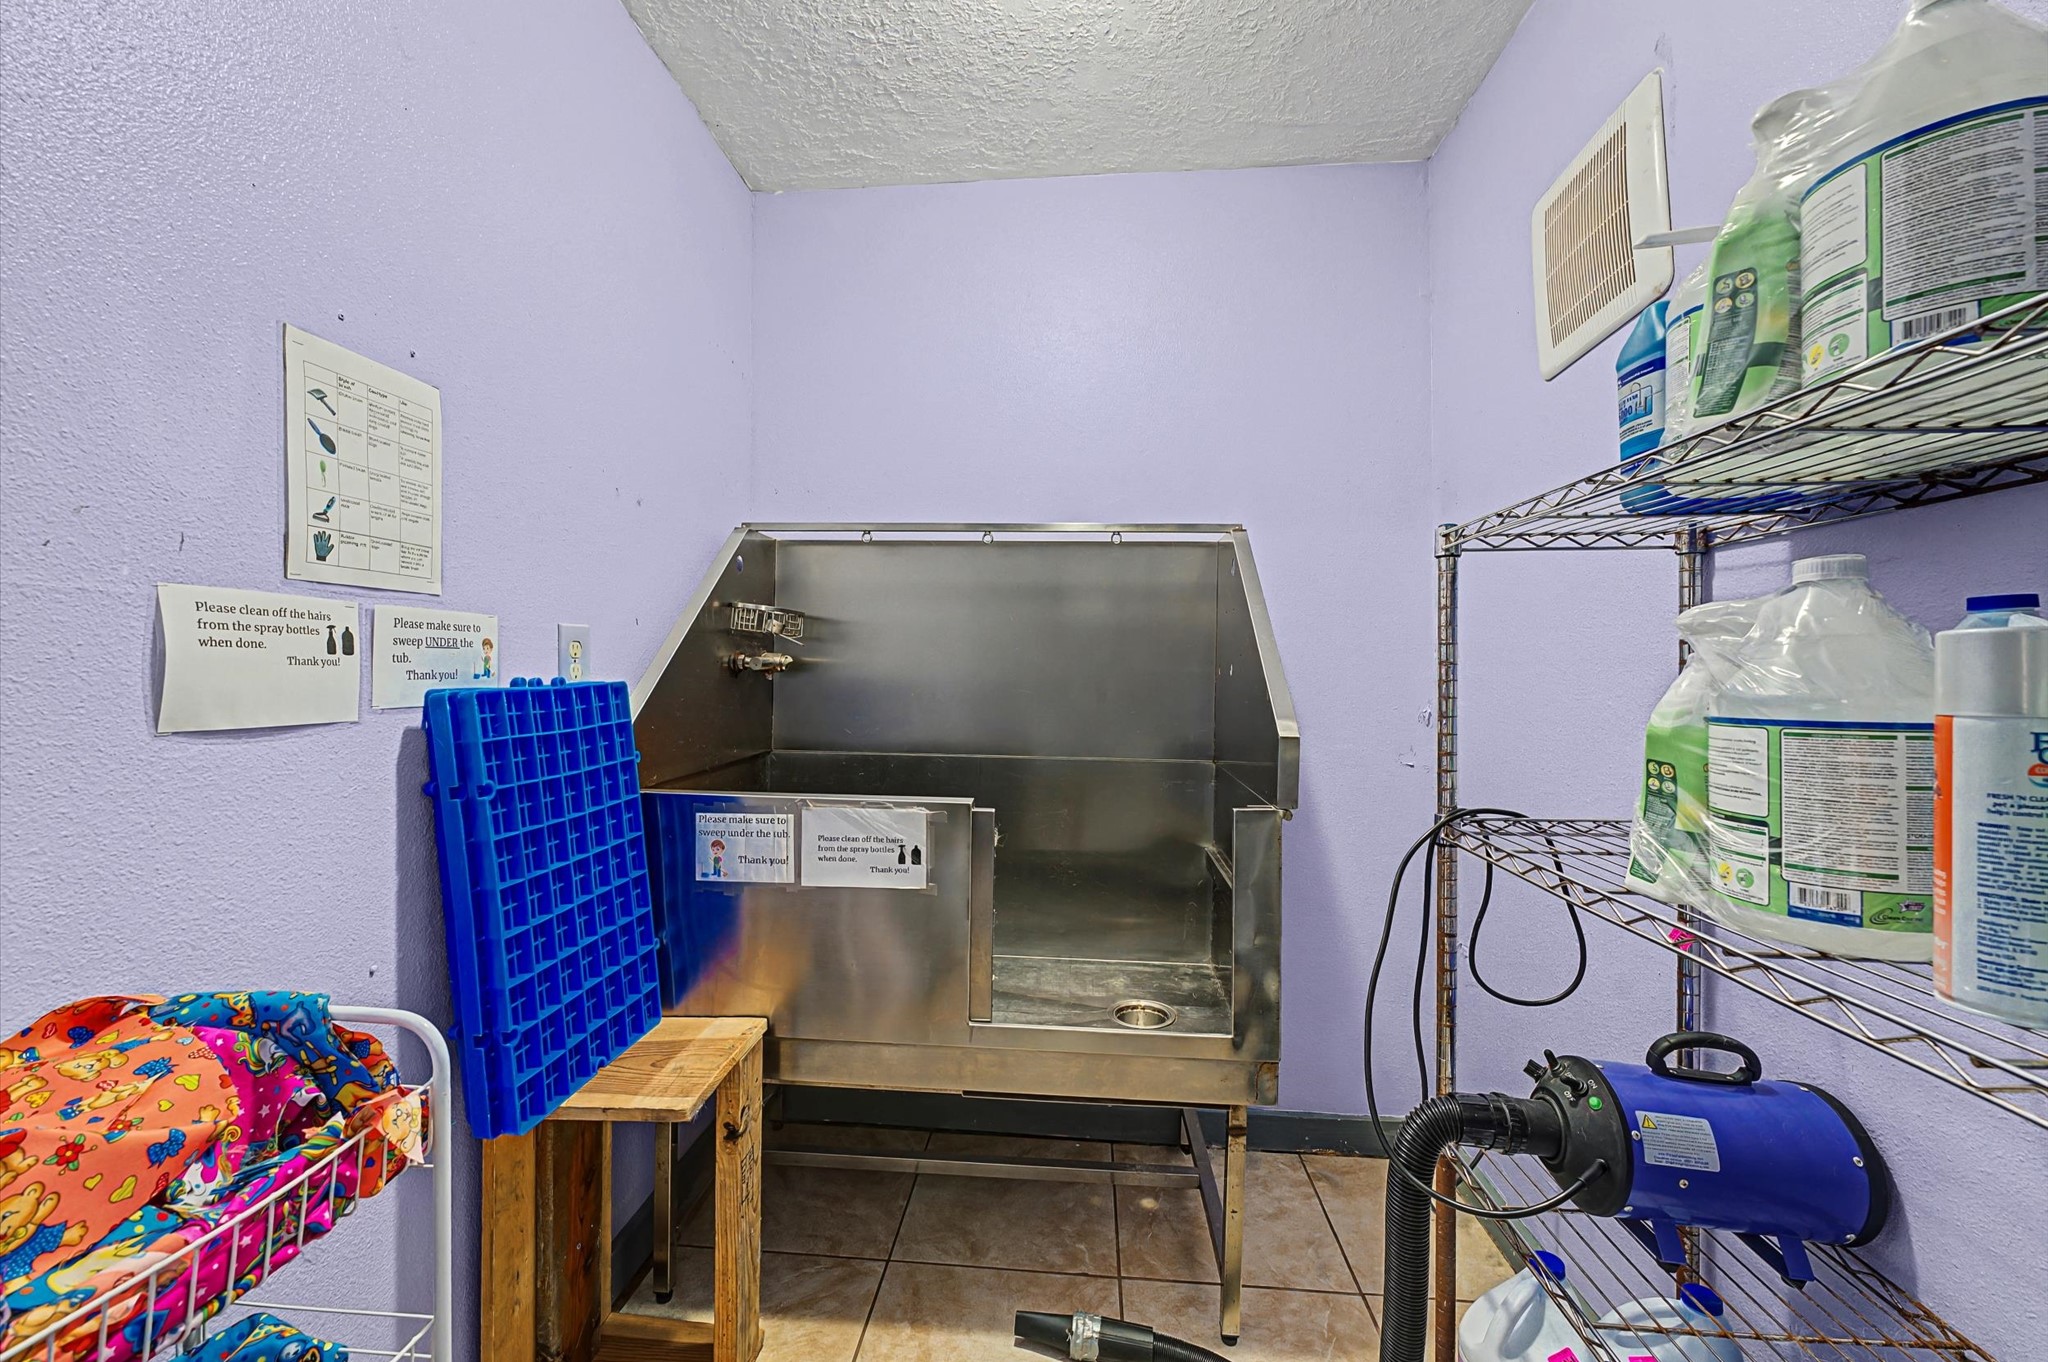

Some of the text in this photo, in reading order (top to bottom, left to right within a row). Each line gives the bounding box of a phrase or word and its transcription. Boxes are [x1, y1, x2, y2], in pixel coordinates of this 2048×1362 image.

[195, 601, 332, 622] Please clean off the hairs
[197, 618, 320, 636] from the spray bottles
[393, 617, 481, 633] Please make sure to
[198, 637, 267, 649] when done.
[392, 636, 474, 649] sweep UNDER the
[287, 656, 341, 668] Thank you!
[392, 652, 412, 663] tub.
[406, 669, 458, 682] Thank you!
[698, 814, 787, 825] Please make sure to
[698, 828, 791, 838] sweep under the tub.
[817, 834, 840, 842] Please
[861, 835, 872, 843] off
[873, 836, 885, 844] the
[885, 836, 904, 844] hairs
[817, 844, 836, 852] from
[849, 846, 869, 854] spray
[870, 846, 895, 854] bottles
[738, 855, 789, 866] Thank you!
[817, 855, 858, 863] when done.
[894, 866, 910, 875] you!
[1588, 1079, 1598, 1089] ON
